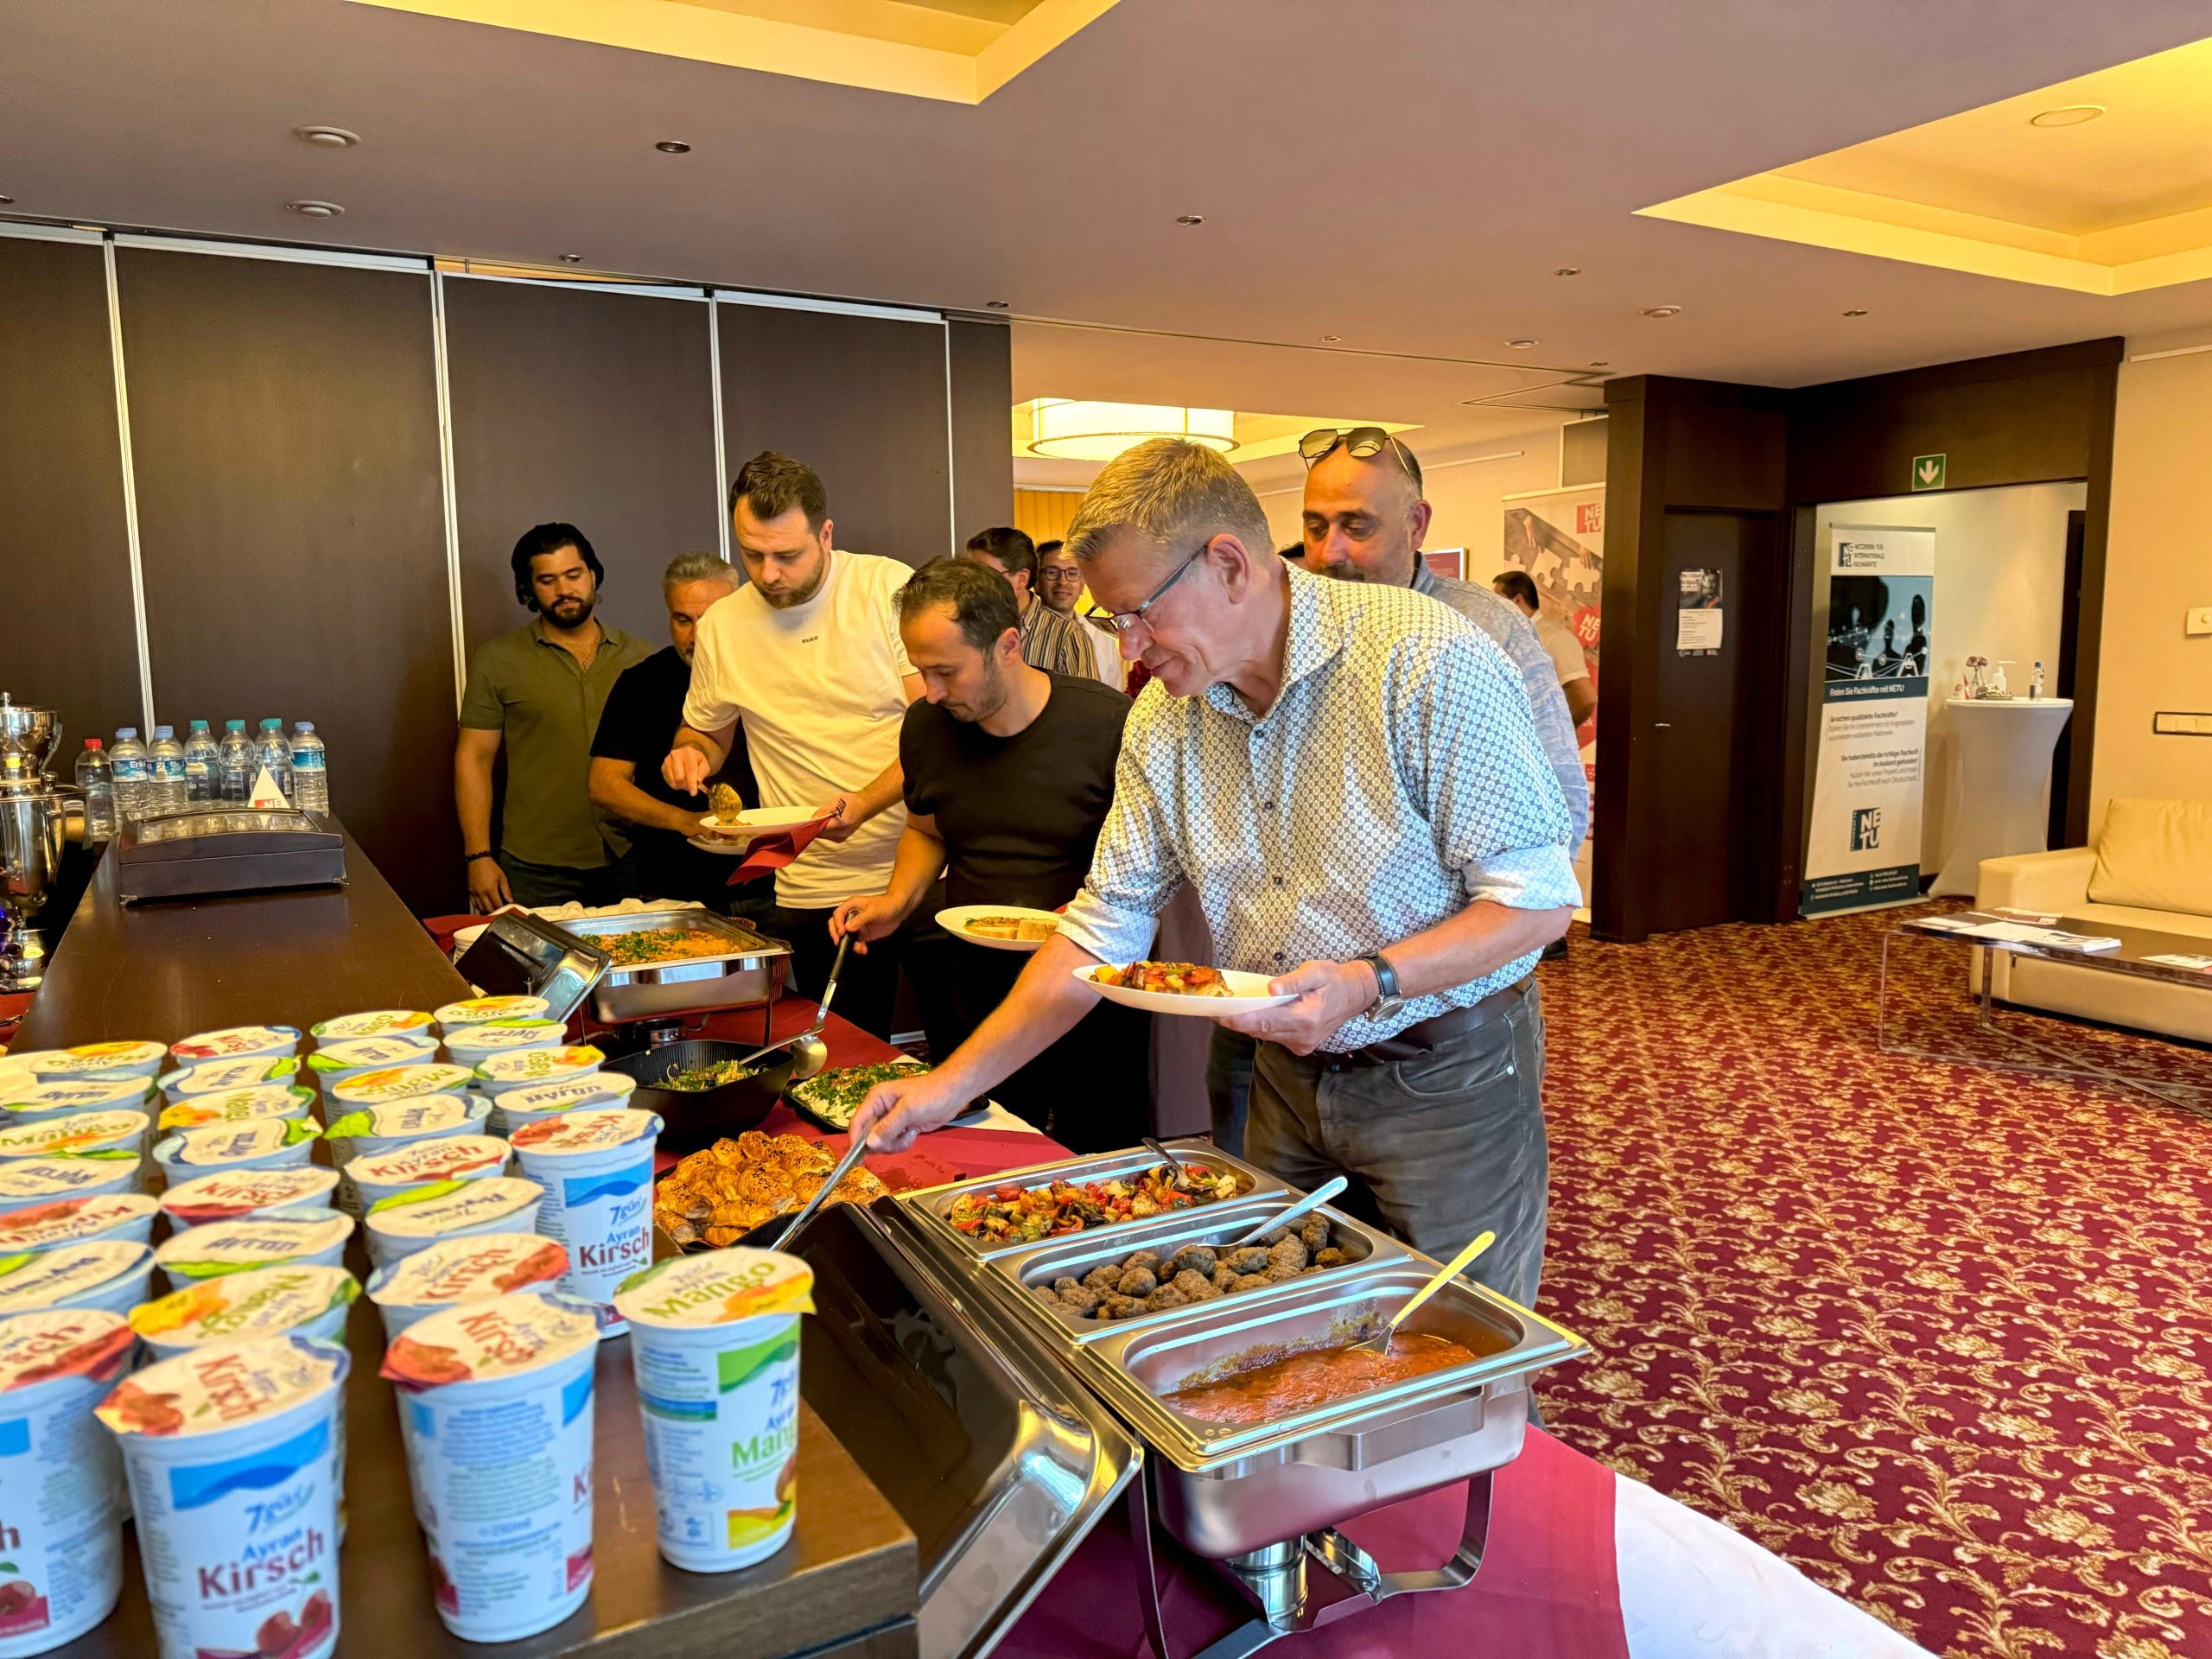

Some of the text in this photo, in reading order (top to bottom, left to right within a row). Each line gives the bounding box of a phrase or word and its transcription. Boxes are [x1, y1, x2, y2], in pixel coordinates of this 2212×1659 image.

[1584, 505, 1601, 521] NE
[1584, 518, 1601, 533] TU
[1582, 613, 1600, 626] NE
[802, 635, 819, 645] HUGO
[1578, 625, 1597, 641] TU
[1889, 683, 1905, 693] NETU
[1861, 809, 1881, 833] NE
[1859, 829, 1880, 850] TU
[368, 1146, 484, 1177] Kirsch
[607, 1225, 640, 1245] Ayran
[579, 1227, 650, 1268] Kirsch
[416, 1249, 512, 1298] Kirsch
[641, 1262, 779, 1319] Mango
[194, 1354, 271, 1421] Kirsch
[732, 1421, 798, 1469] Mang
[198, 1527, 324, 1599] Kirsch
